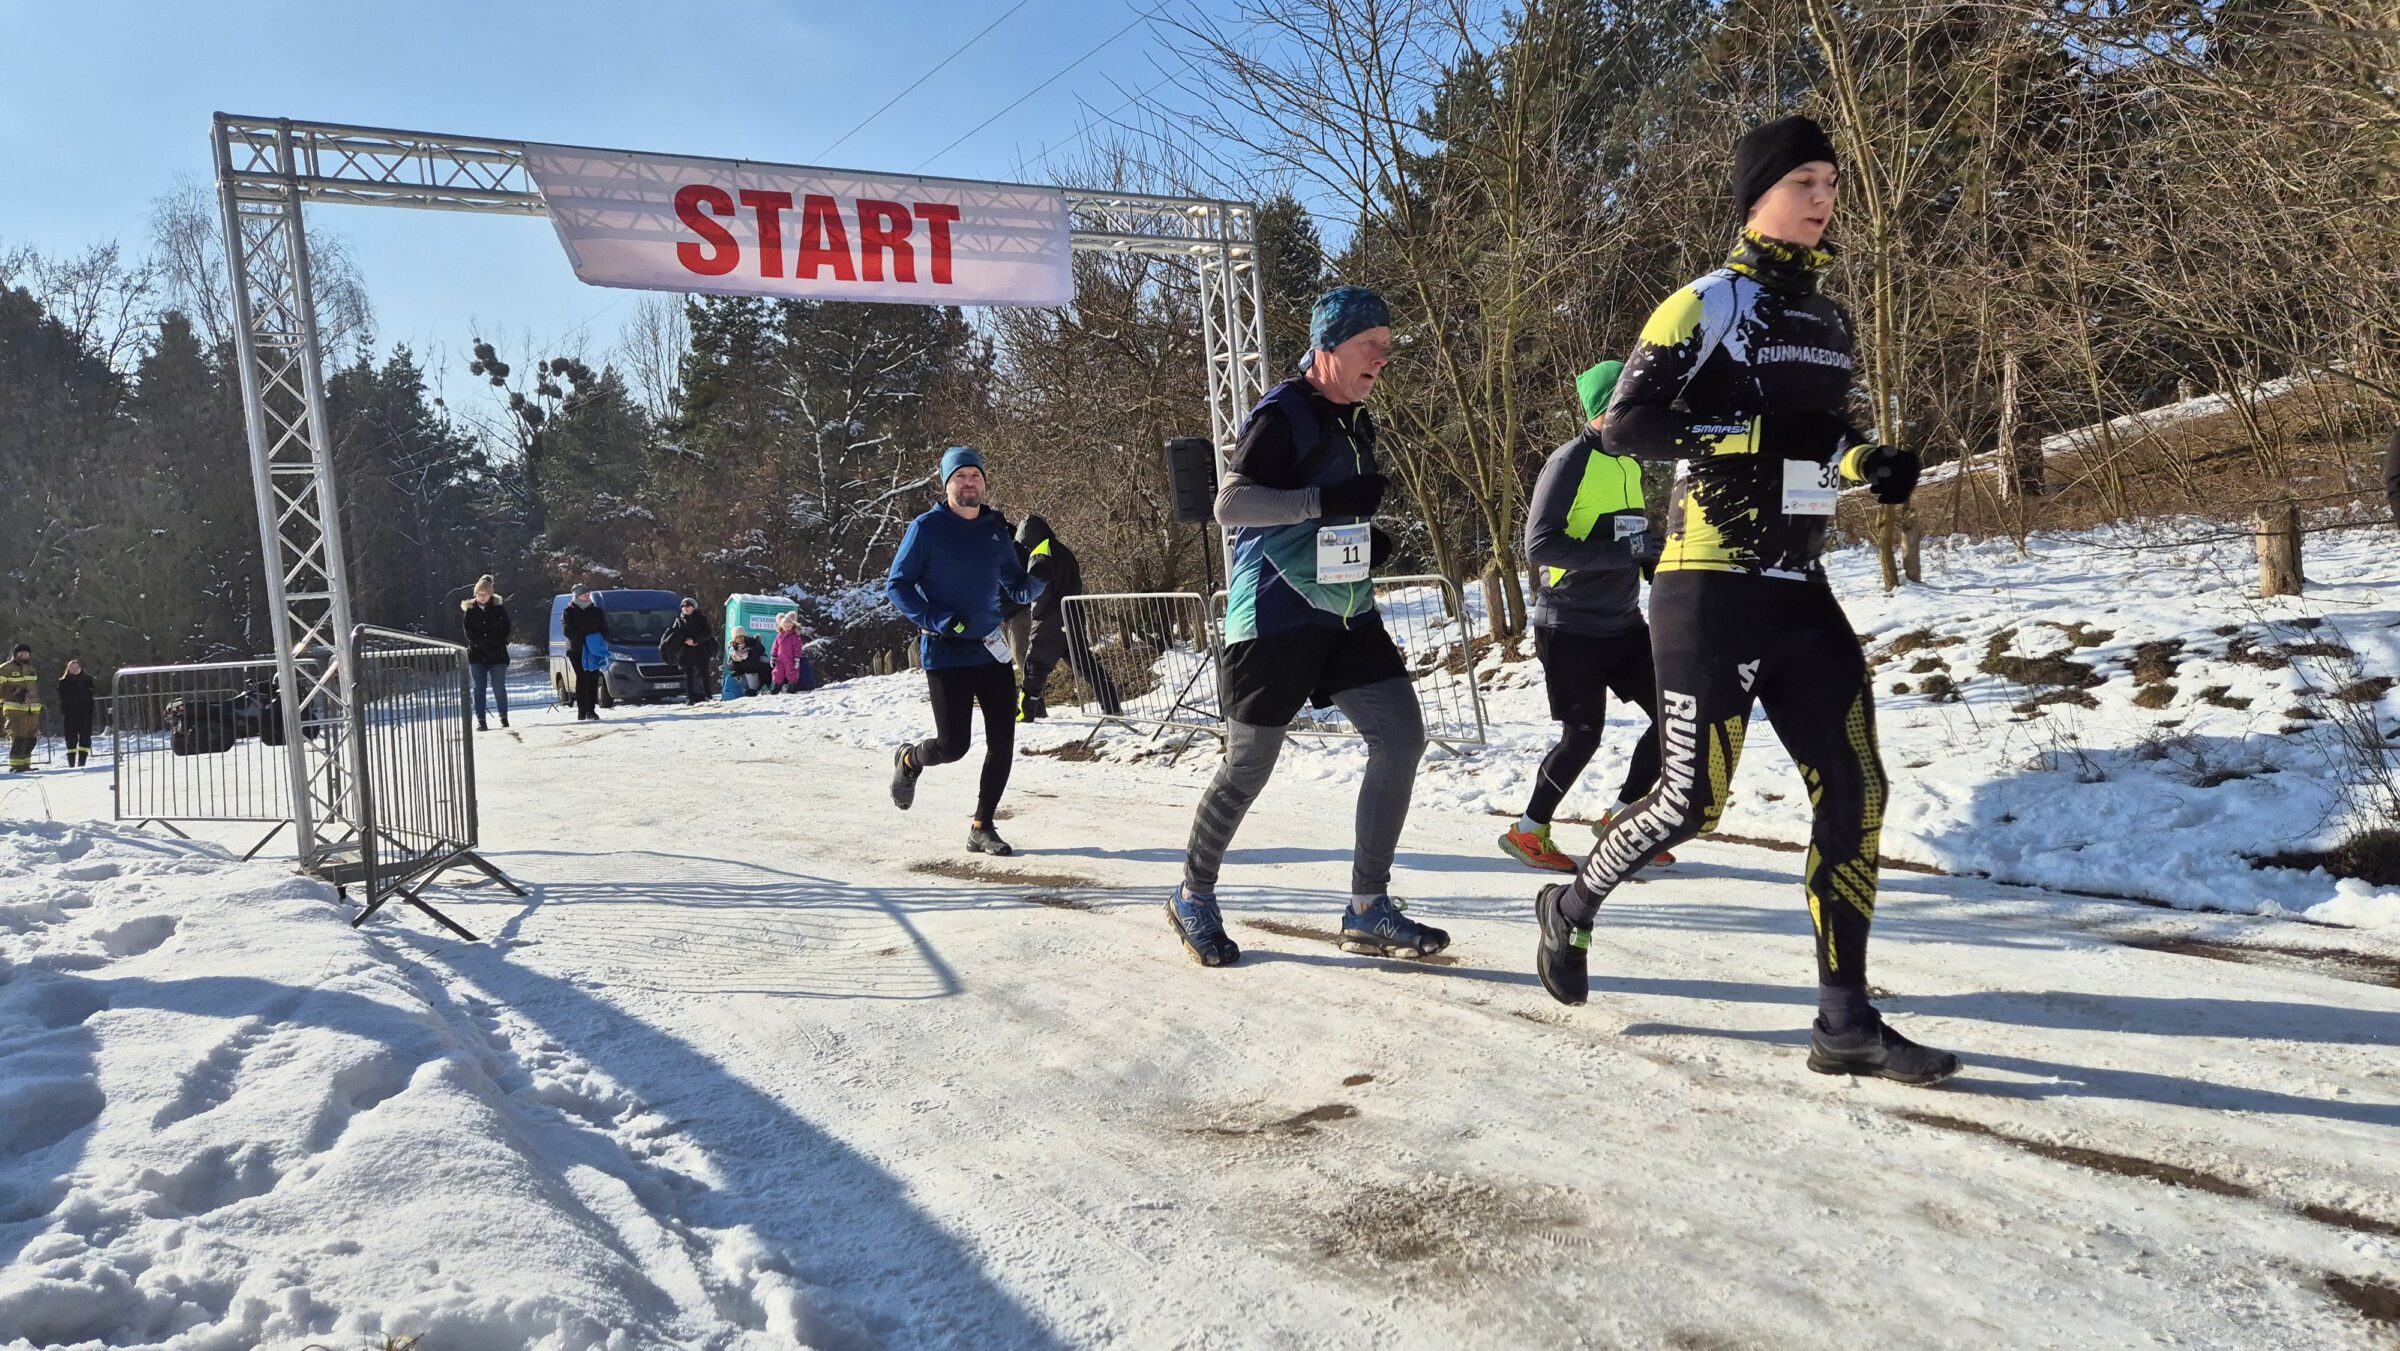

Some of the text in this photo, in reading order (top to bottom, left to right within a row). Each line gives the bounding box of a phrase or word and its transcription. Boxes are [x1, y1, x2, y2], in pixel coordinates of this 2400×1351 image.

[673, 184, 961, 285] START
[1757, 344, 1852, 370] RUNMAGEDDON
[1818, 464, 1840, 489] 38
[1342, 545, 1361, 565] 11
[1582, 690, 1698, 896] RUNMAGEDDON
